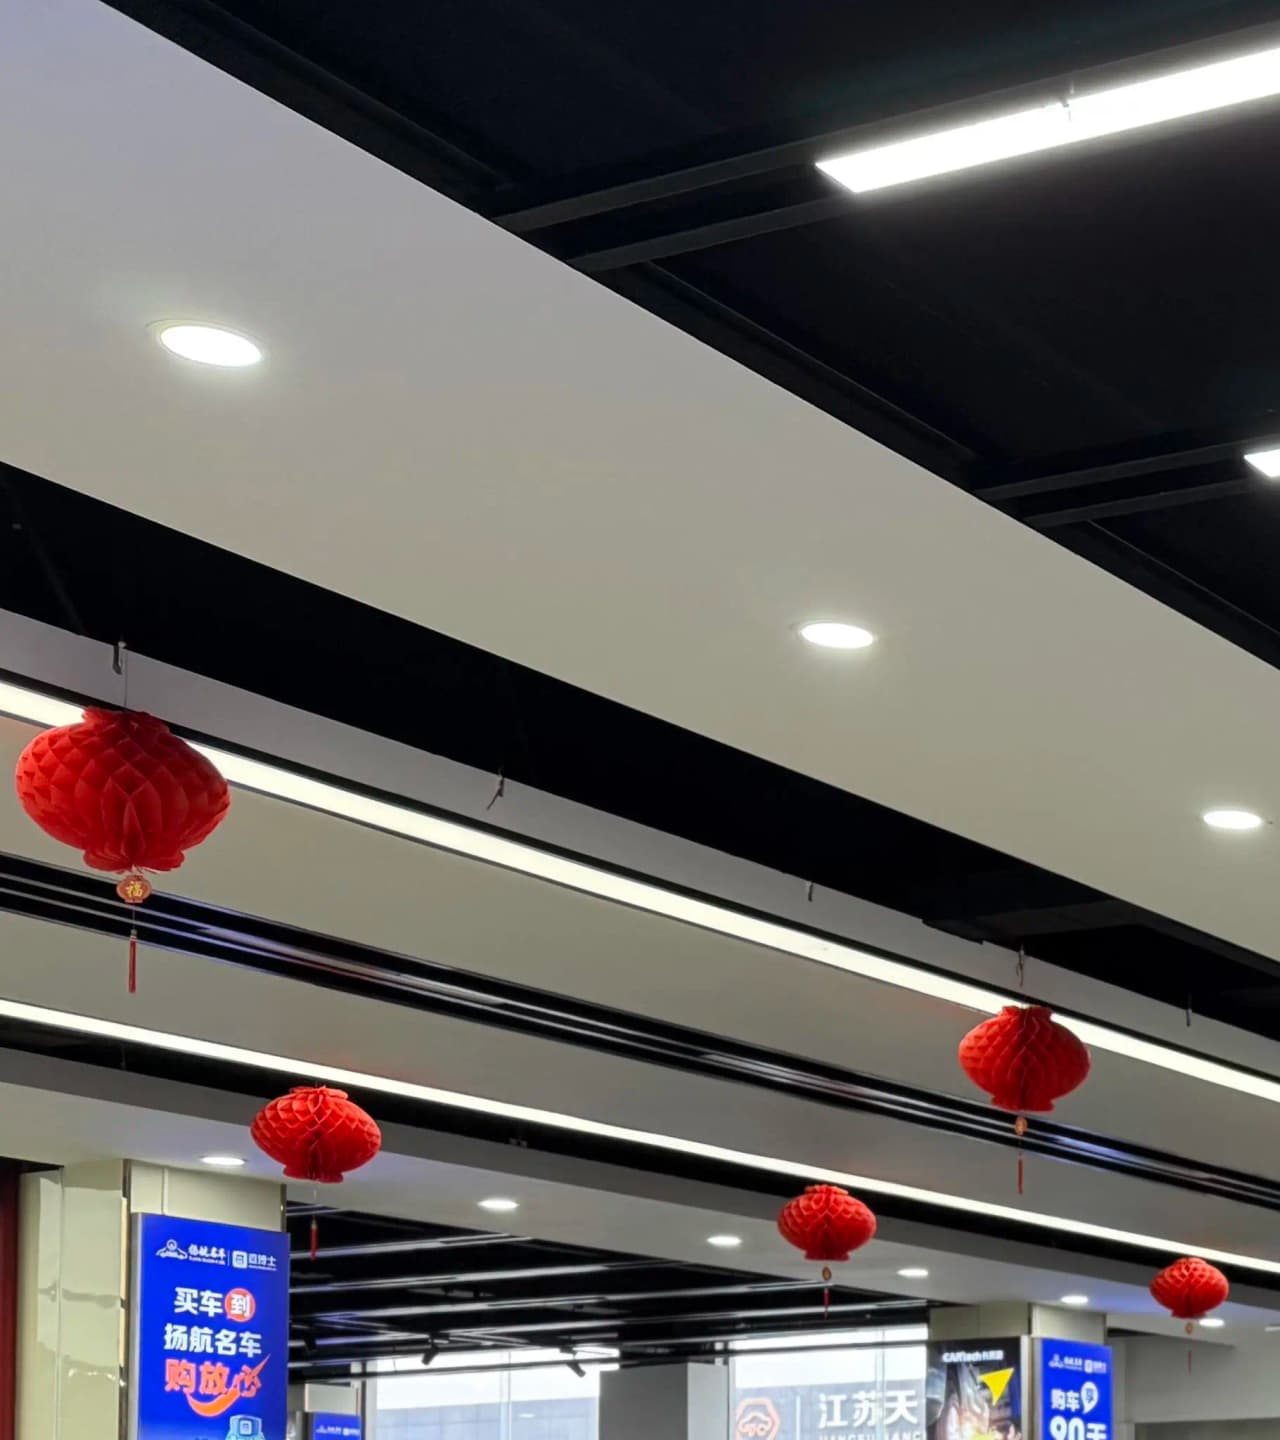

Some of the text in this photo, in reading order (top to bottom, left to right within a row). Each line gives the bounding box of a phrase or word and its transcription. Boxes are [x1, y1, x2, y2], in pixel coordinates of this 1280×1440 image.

[174, 1286, 251, 1318] 买车到
[163, 1322, 263, 1358] 扬航名车
[165, 1355, 267, 1400] 购放心
